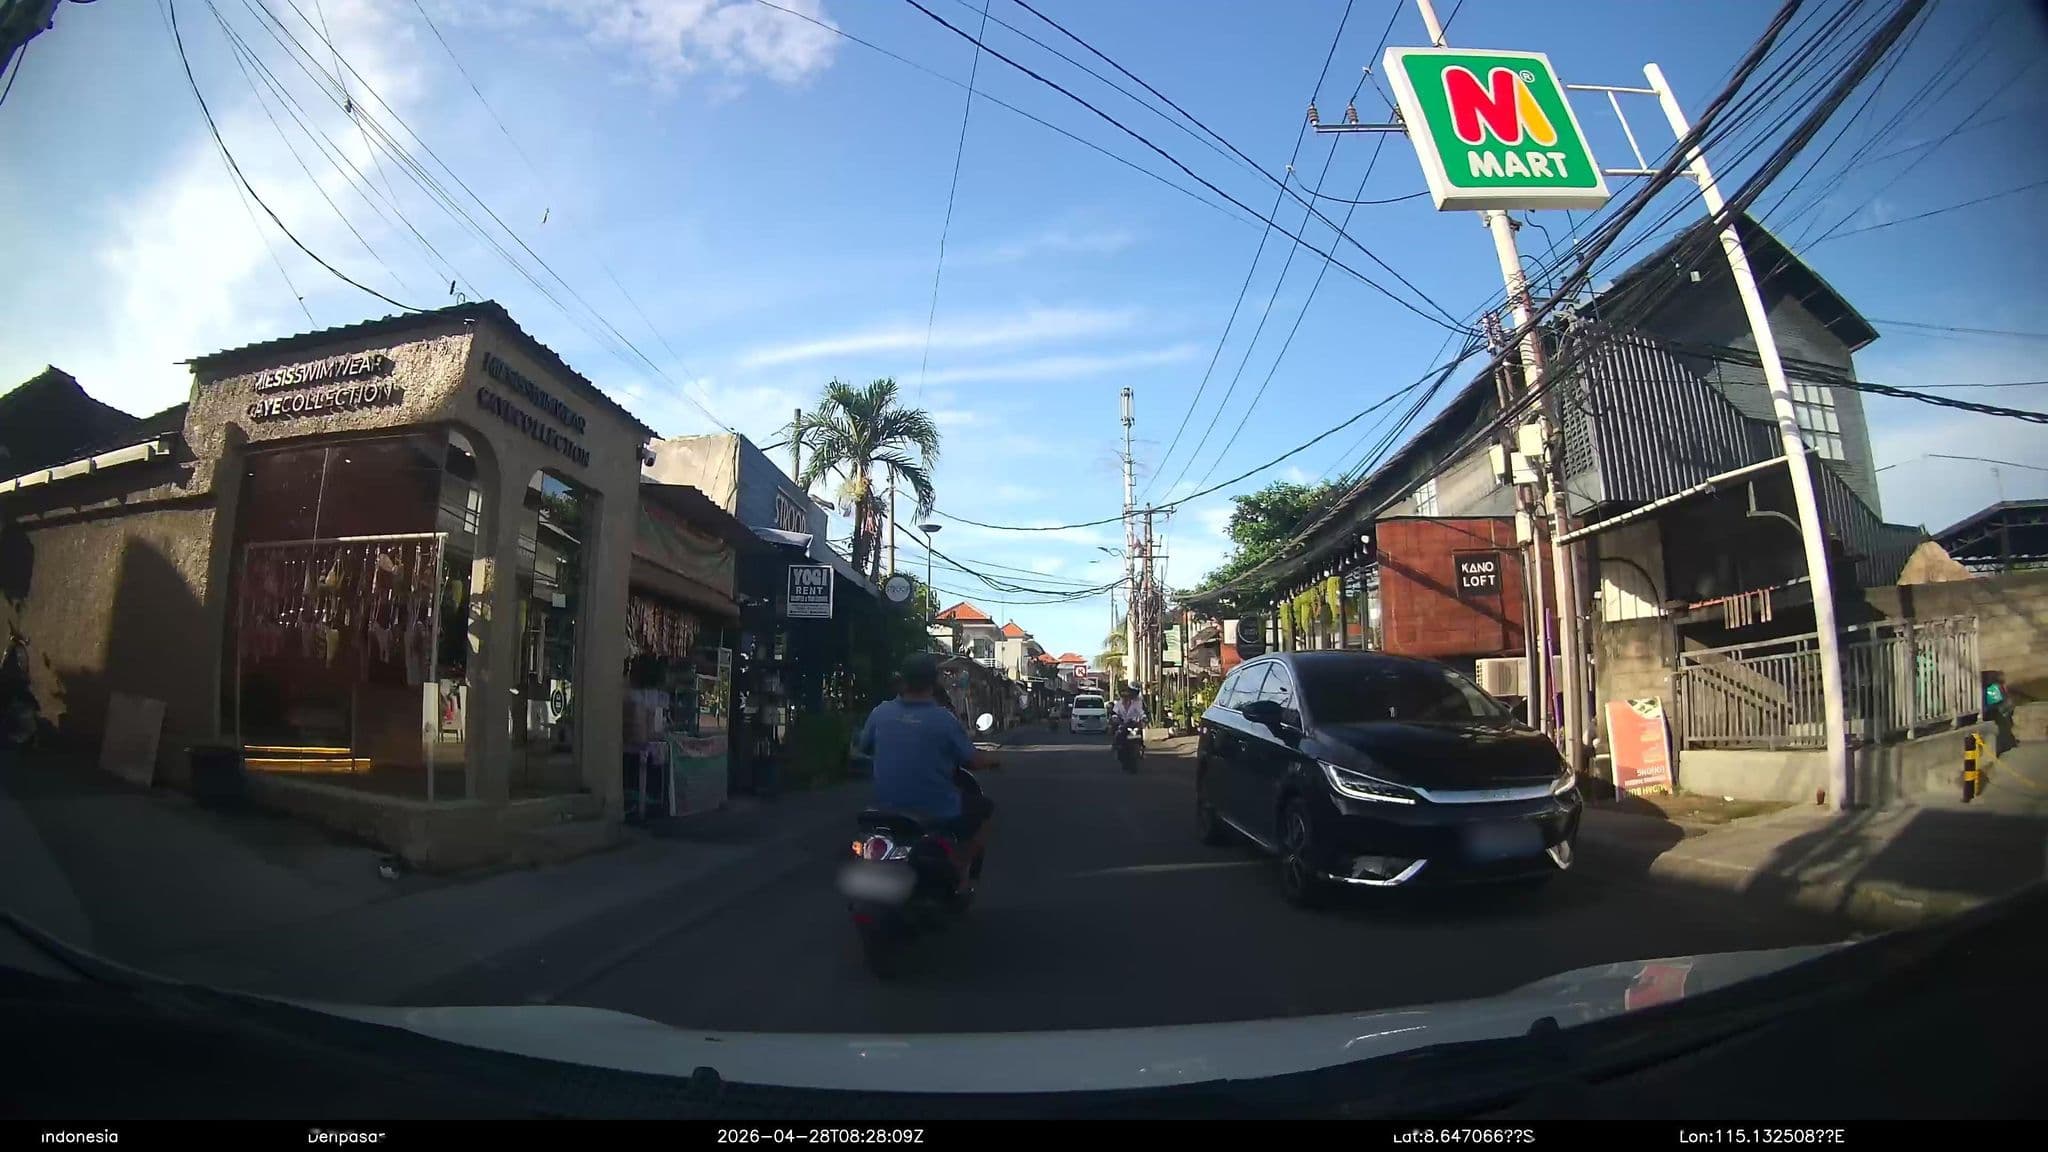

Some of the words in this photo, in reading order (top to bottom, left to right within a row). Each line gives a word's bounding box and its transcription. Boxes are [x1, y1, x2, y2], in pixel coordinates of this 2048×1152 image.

[1467, 151, 1569, 179] MART
[1461, 561, 1494, 573] KANO
[793, 568, 828, 585] YOGI
[1463, 574, 1496, 587] LOFT
[795, 586, 823, 595] RENT
